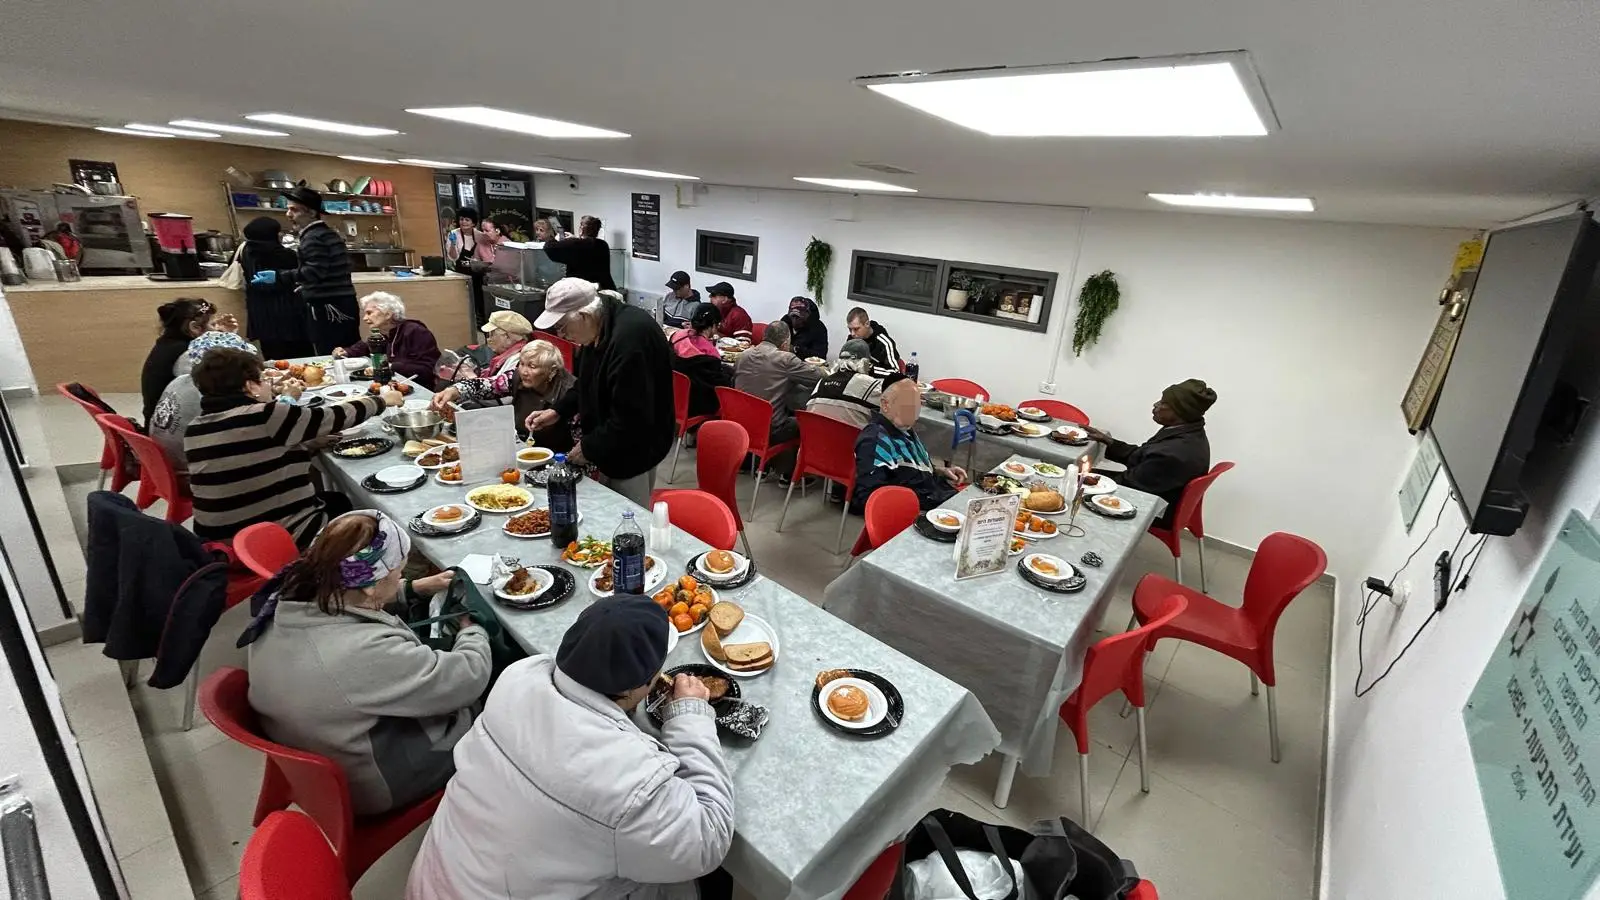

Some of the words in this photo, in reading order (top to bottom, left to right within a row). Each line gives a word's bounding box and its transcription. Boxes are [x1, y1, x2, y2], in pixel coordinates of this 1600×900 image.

[1525, 727, 1559, 807] התביעות
[1573, 762, 1597, 808] הודות
[1552, 801, 1585, 869] ועידת
